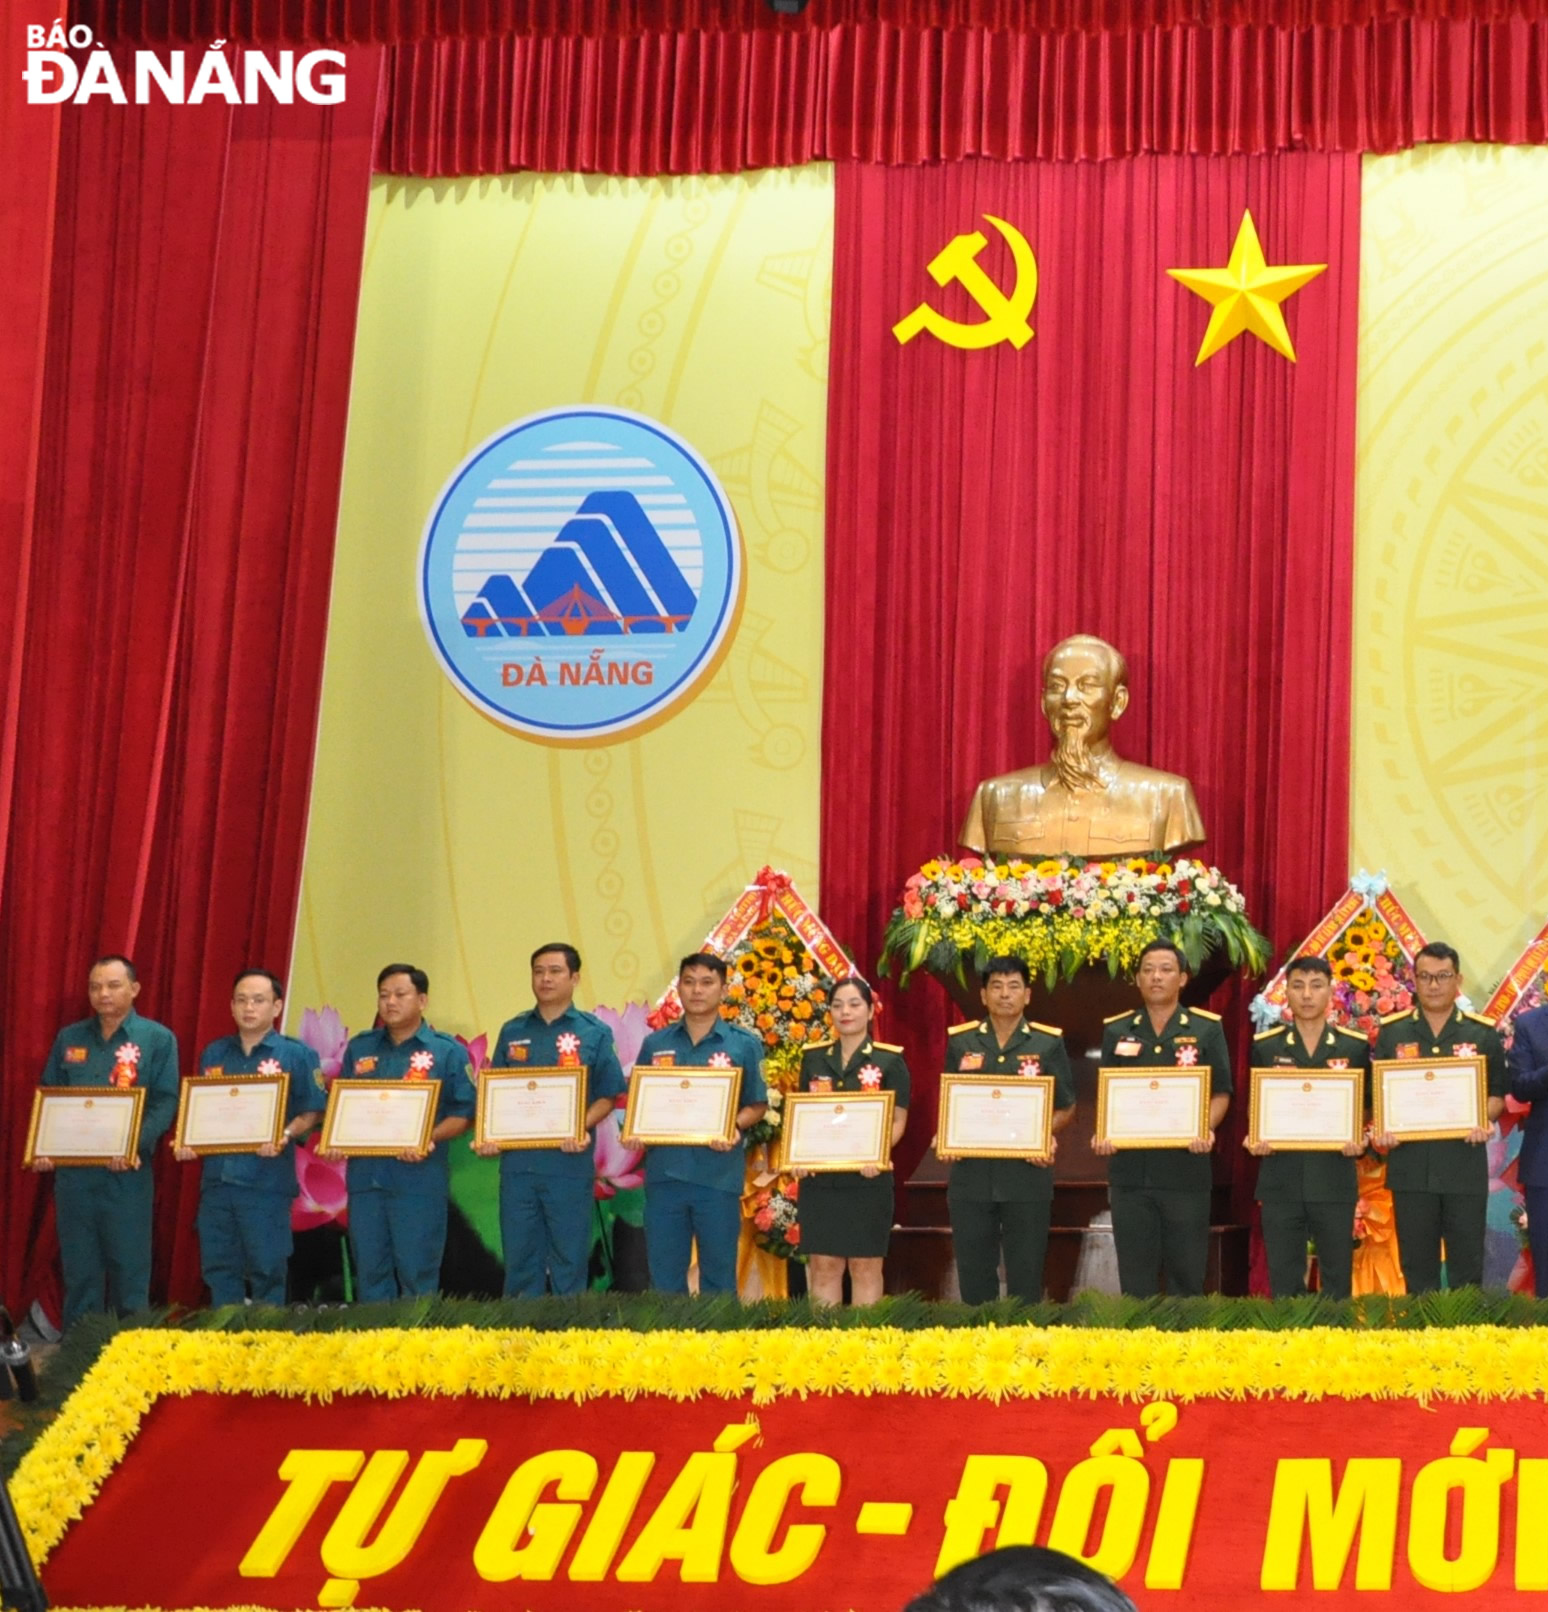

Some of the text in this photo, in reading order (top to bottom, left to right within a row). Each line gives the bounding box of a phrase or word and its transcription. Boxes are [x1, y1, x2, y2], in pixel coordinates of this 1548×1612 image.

[501, 648, 655, 687] ĐÀ NẴNG
[237, 1437, 489, 1608] TỰ
[472, 1421, 843, 1586] GIÁC
[933, 1400, 1206, 1591] ĐỔI
